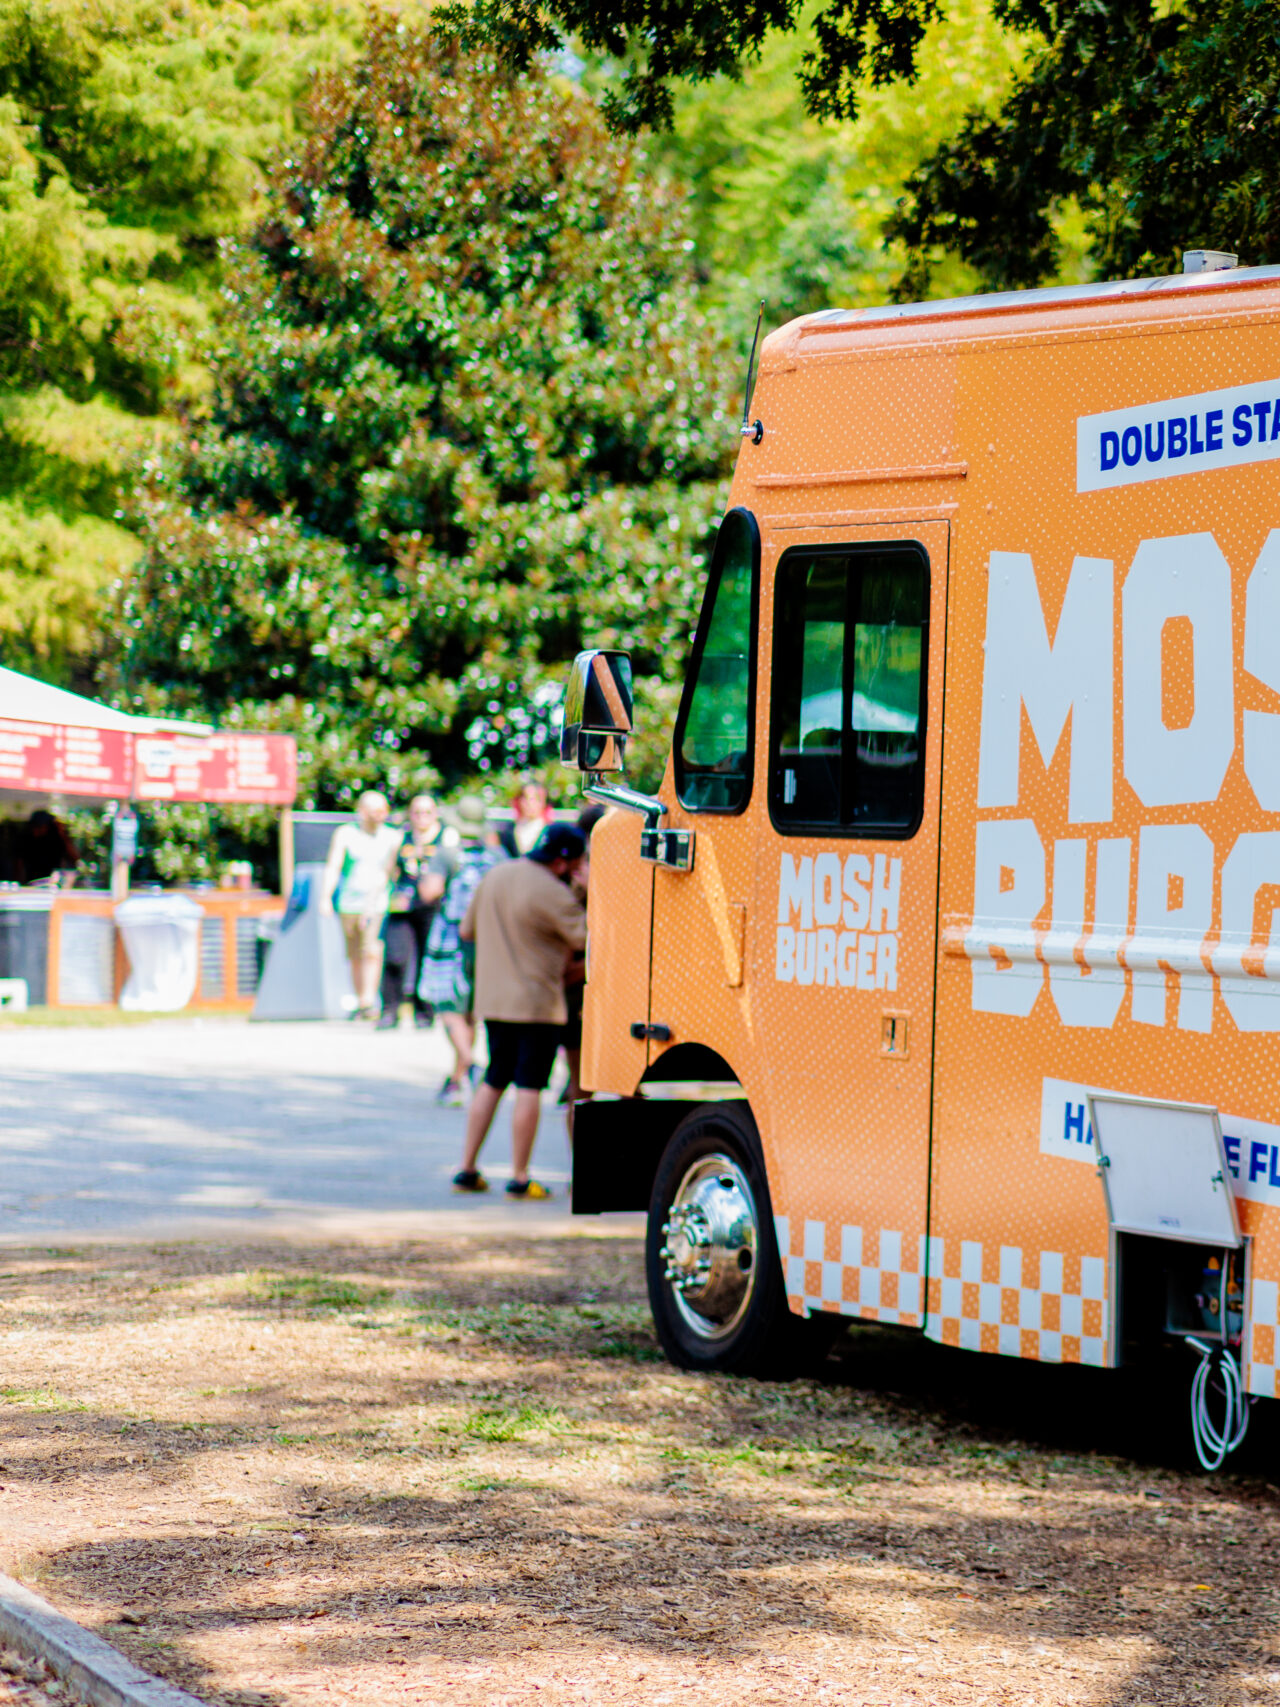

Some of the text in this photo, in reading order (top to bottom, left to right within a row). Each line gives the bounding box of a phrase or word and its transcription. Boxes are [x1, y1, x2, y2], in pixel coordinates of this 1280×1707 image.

[1100, 409, 1223, 472] DOUBLE
[777, 852, 903, 932] MOSH
[775, 926, 899, 992] BURGER
